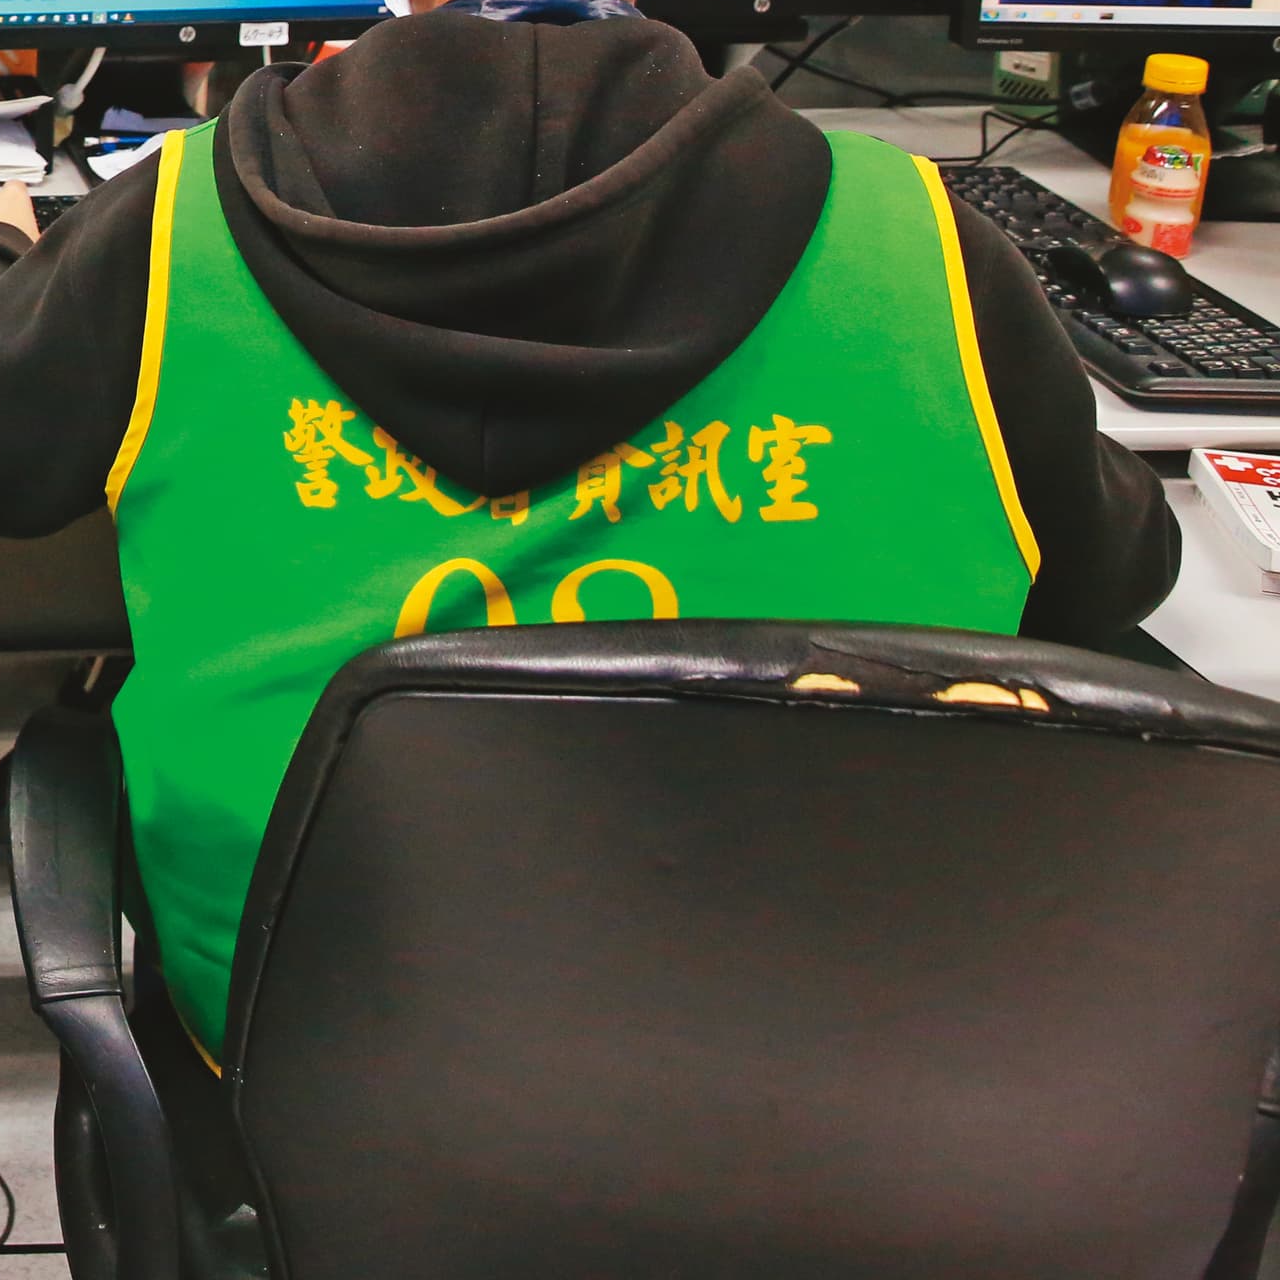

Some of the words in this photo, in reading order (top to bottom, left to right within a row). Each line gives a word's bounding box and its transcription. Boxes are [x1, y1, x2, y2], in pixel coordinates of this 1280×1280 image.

[283, 397, 834, 527] 警政資訊室
